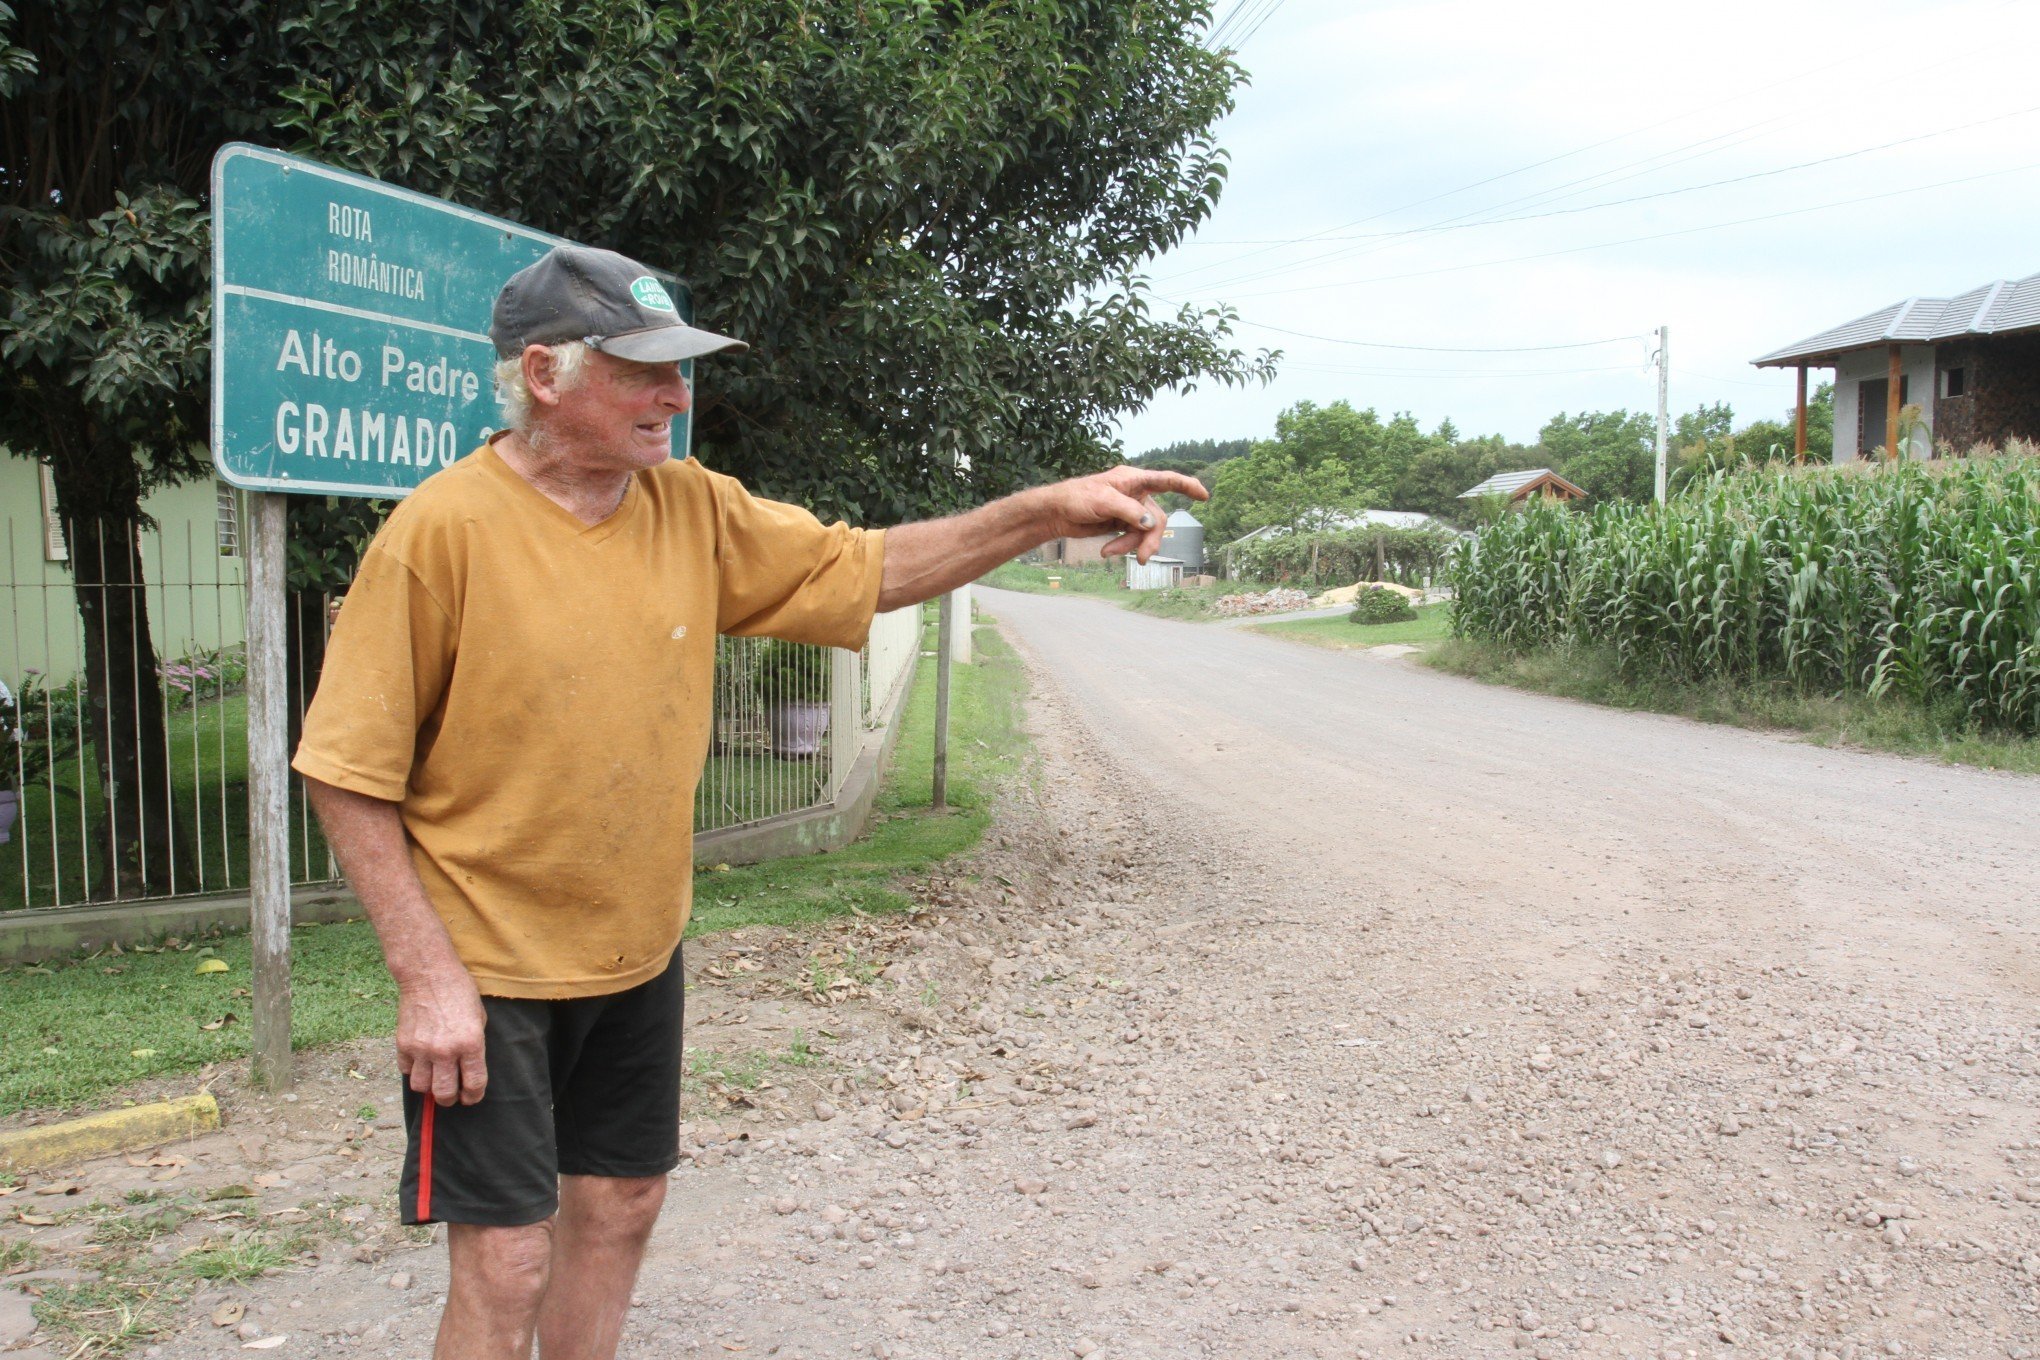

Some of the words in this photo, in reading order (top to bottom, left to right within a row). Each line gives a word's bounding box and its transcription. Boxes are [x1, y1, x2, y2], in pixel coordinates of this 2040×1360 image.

[329, 202, 372, 243] ROTA
[328, 249, 424, 301] ROMÂNTICA
[276, 329, 362, 382] Alto
[381, 345, 479, 401] Padre
[276, 401, 457, 468] GRAMADO
